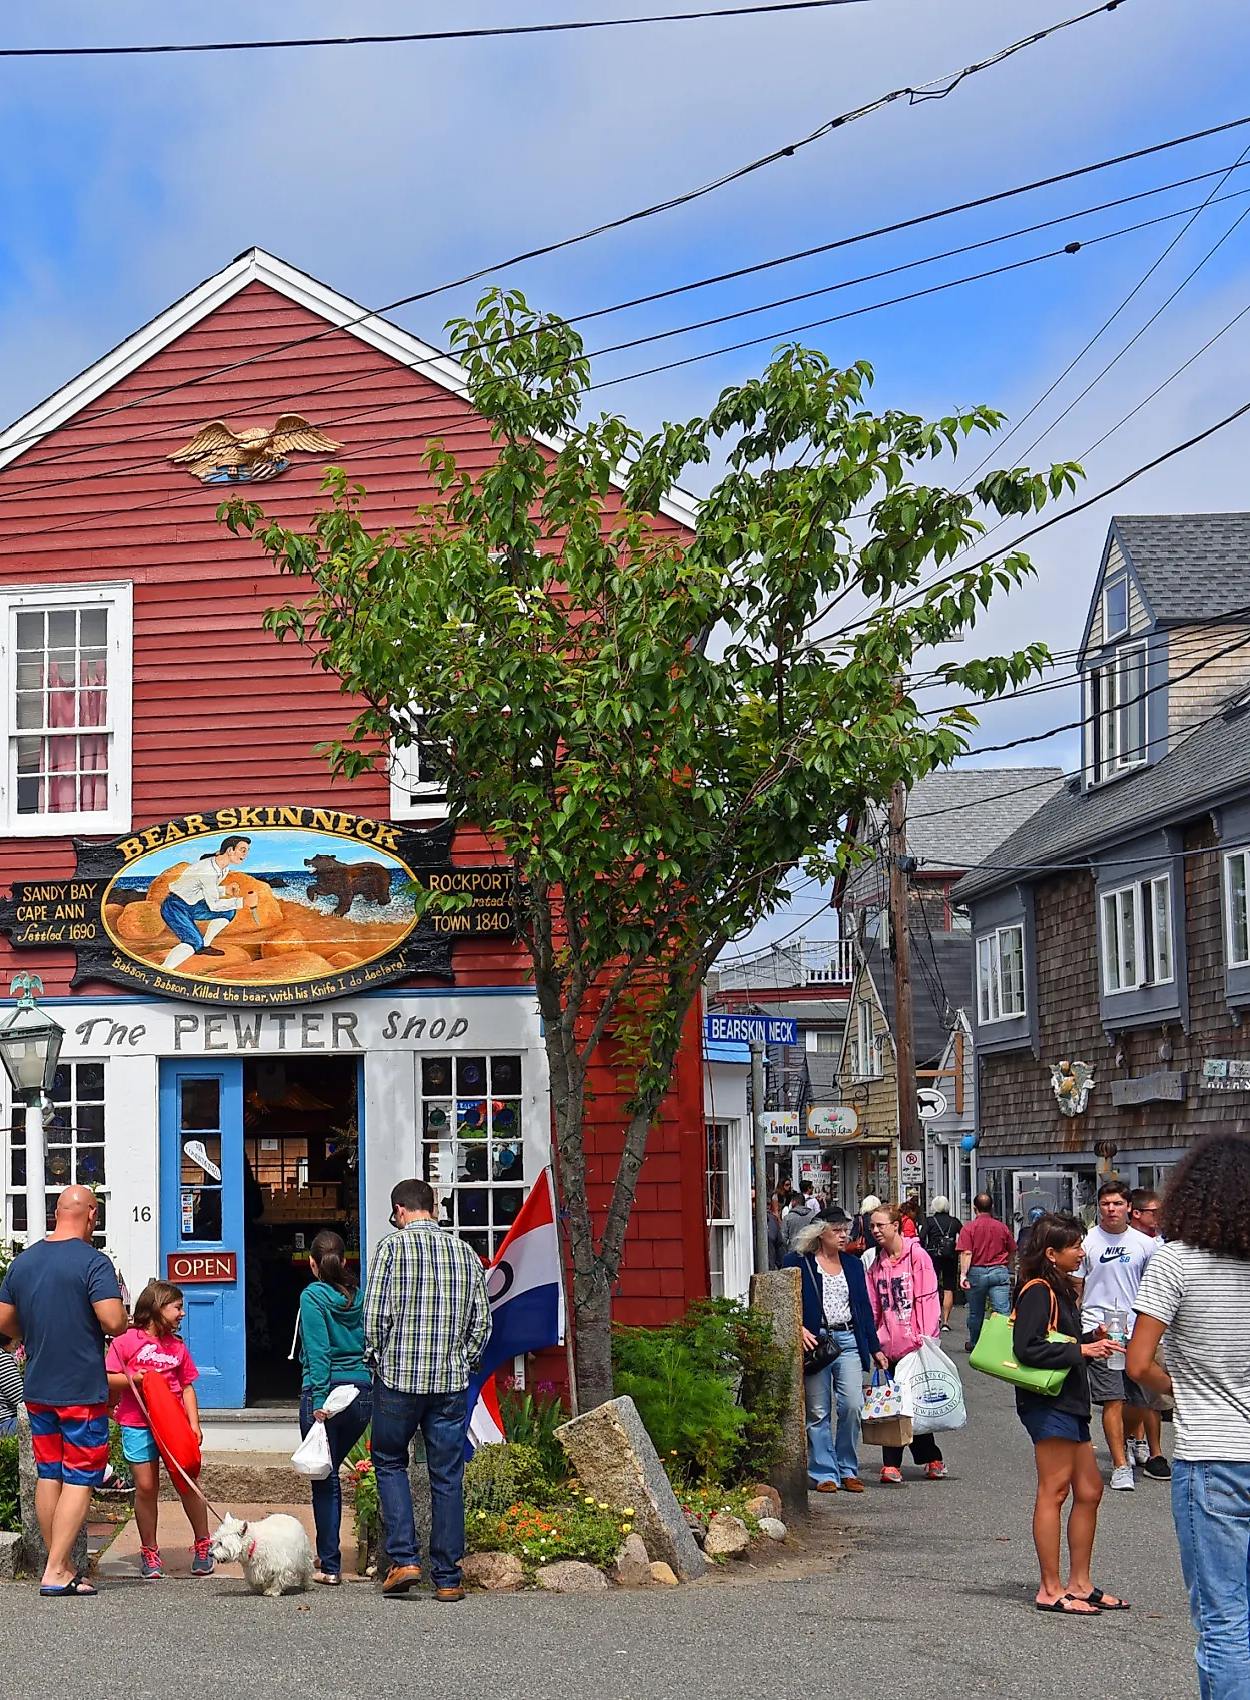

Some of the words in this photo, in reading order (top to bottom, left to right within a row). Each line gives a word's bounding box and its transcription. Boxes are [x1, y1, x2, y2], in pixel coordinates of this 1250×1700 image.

[116, 815, 210, 861] BEAR
[215, 806, 303, 829] SKIN
[311, 809, 403, 851] NECK
[430, 873, 514, 892] ROCKPORT
[23, 885, 68, 902] SANDY
[71, 883, 97, 900] BAY
[16, 905, 47, 922] CAPE
[54, 904, 85, 920] ANN
[431, 915, 470, 932] TOWN
[475, 912, 510, 931] 1840
[17, 923, 66, 942] Settled
[69, 923, 96, 940] 1690
[192, 985, 220, 1000] Killed
[223, 989, 239, 1001] the
[270, 988, 293, 1002] with
[295, 984, 308, 999] his
[311, 980, 336, 998] Knife
[337, 978, 346, 990] I
[350, 976, 362, 987] do
[74, 1016, 147, 1047] The
[174, 1012, 362, 1051] PEWTER
[382, 1010, 470, 1041] Shop
[712, 1019, 766, 1041] BEARSKIN
[768, 1022, 793, 1042] NECK
[132, 1205, 152, 1222] 16
[1105, 1246, 1127, 1255] NIKE
[174, 1258, 231, 1277] OPEN
